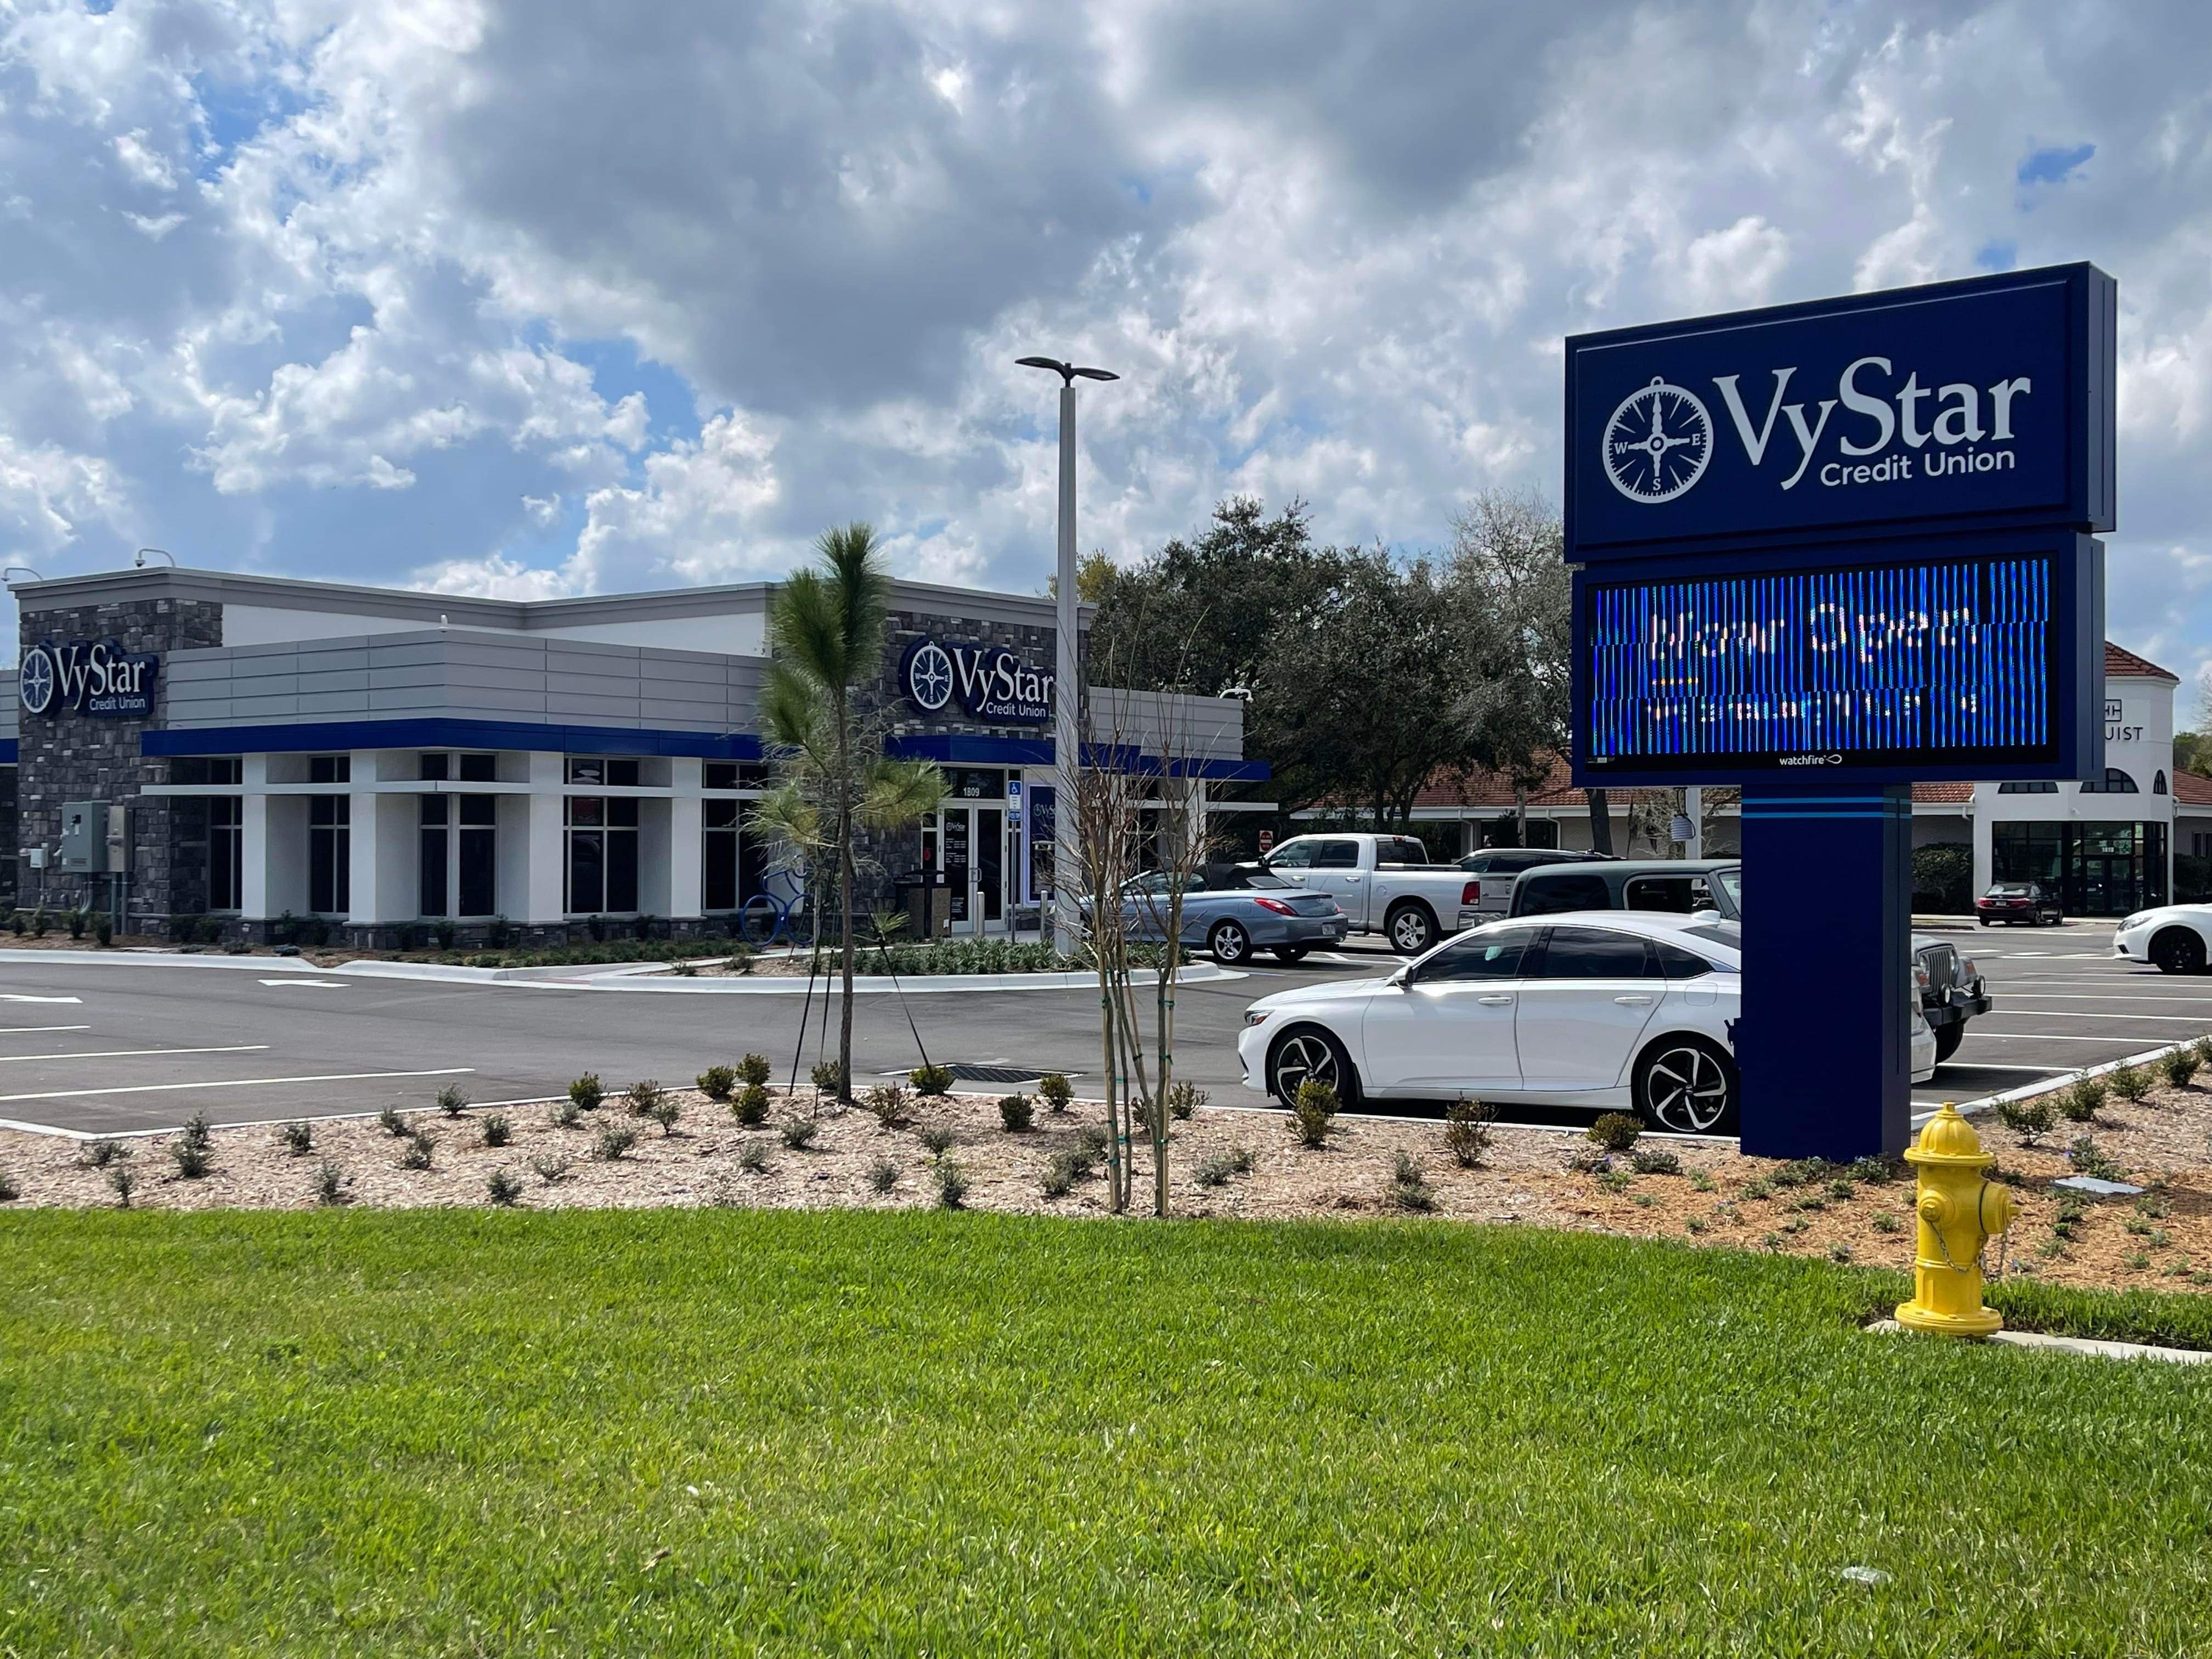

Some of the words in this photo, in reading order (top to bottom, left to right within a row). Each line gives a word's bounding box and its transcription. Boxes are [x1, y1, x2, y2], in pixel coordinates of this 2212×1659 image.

[1713, 356, 2031, 490] VyStar
[1691, 433, 1701, 446] E
[1614, 442, 1628, 455] W
[1820, 454, 1912, 487] Credit
[1924, 448, 2015, 477] Union
[1652, 477, 1661, 492] S
[54, 644, 145, 710] VyStar
[952, 648, 1053, 712] VyStar
[89, 696, 117, 710] Credit
[119, 695, 145, 709] Union
[986, 702, 1015, 715] Credit
[1019, 704, 1046, 717] Union
[1779, 755, 1824, 765] watchfire
[963, 787, 980, 797] 1809
